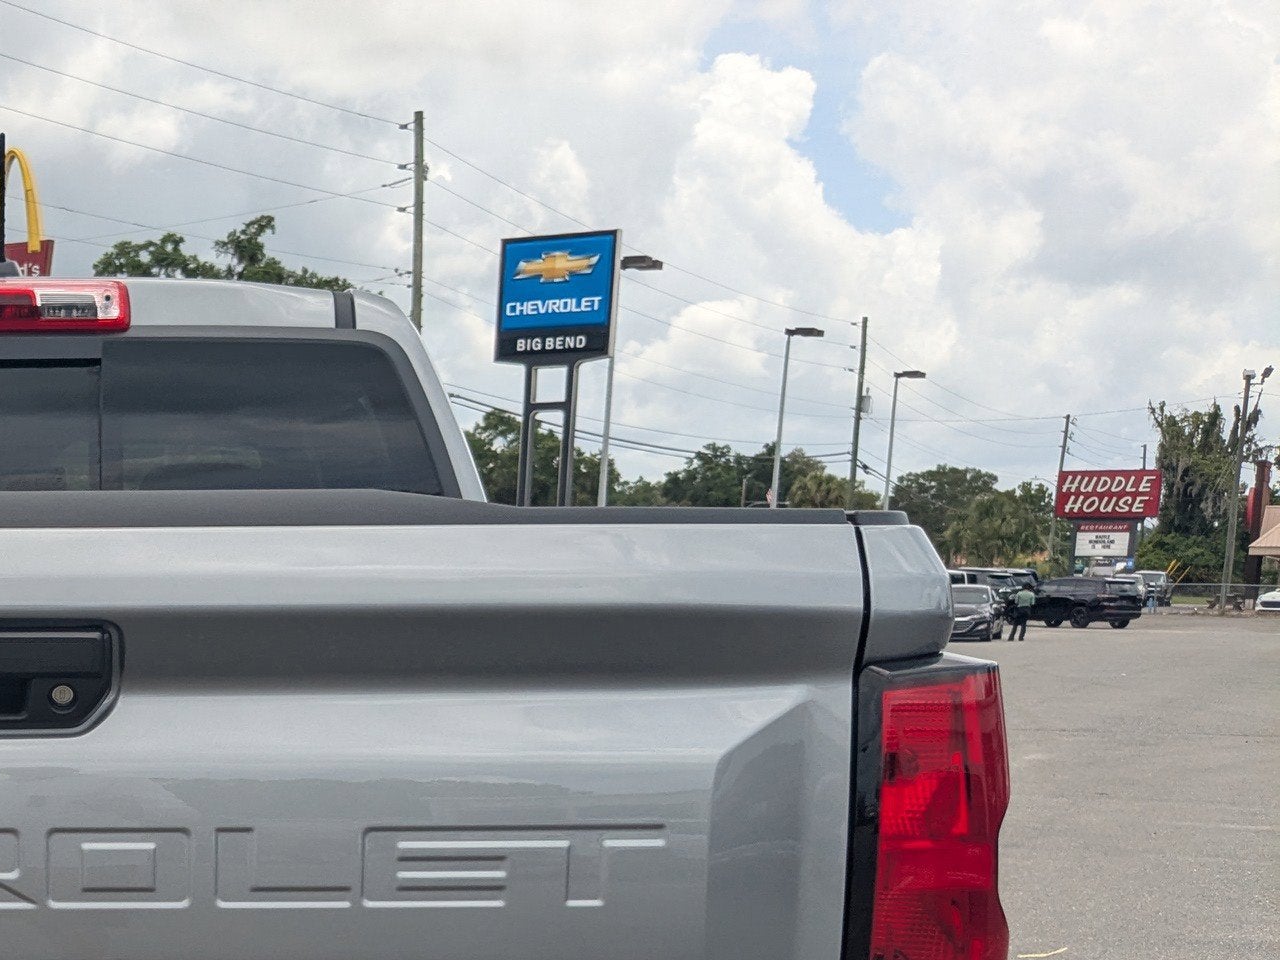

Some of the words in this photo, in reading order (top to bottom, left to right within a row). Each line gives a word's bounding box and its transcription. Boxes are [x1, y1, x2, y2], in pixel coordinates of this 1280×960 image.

[506, 297, 602, 317] CHEVROLET
[516, 338, 542, 352] BIG
[545, 335, 587, 350] BEND
[1062, 475, 1156, 493] HUDDLE
[1064, 495, 1150, 513] HOUSE
